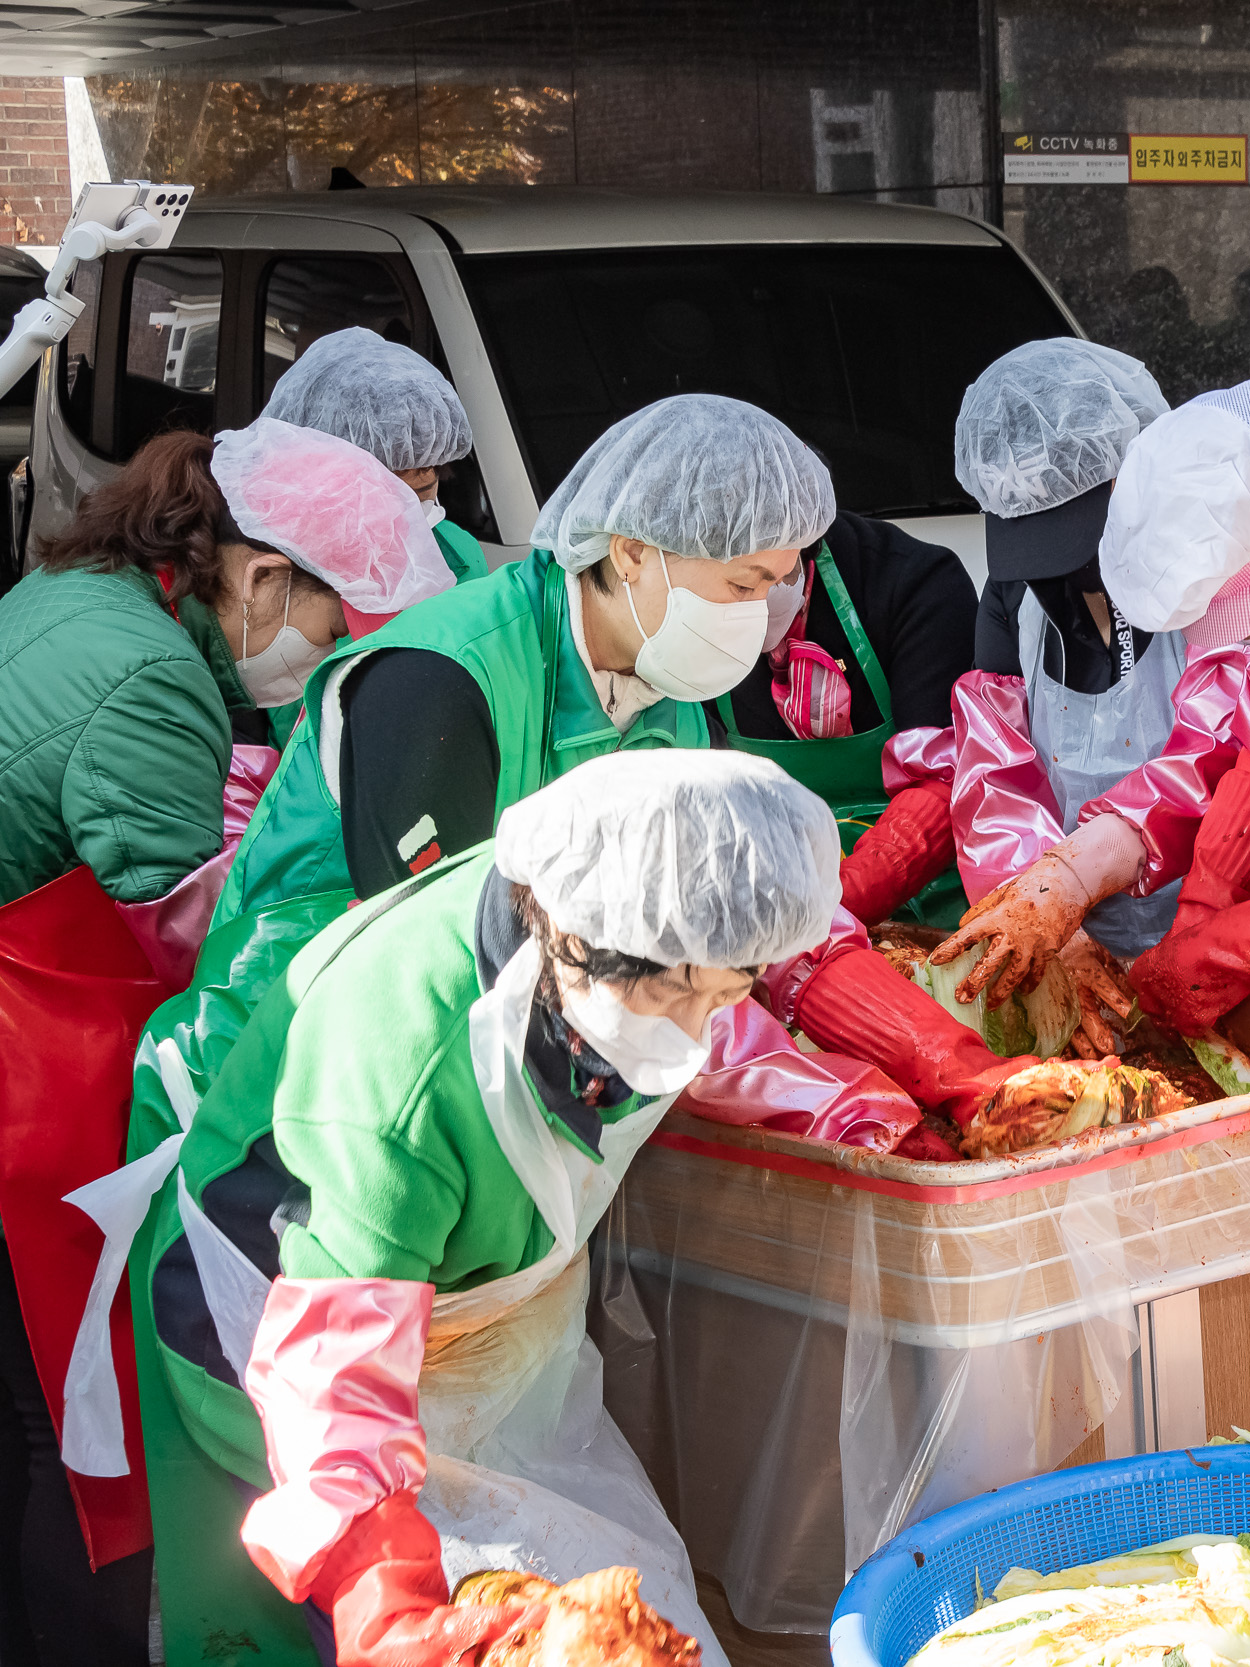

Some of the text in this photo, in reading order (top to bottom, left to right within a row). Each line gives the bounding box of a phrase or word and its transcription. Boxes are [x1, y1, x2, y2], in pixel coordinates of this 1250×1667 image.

[1040, 136, 1118, 151] CCTV 녹화중
[1135, 148, 1242, 169] 입주자외주차금지
